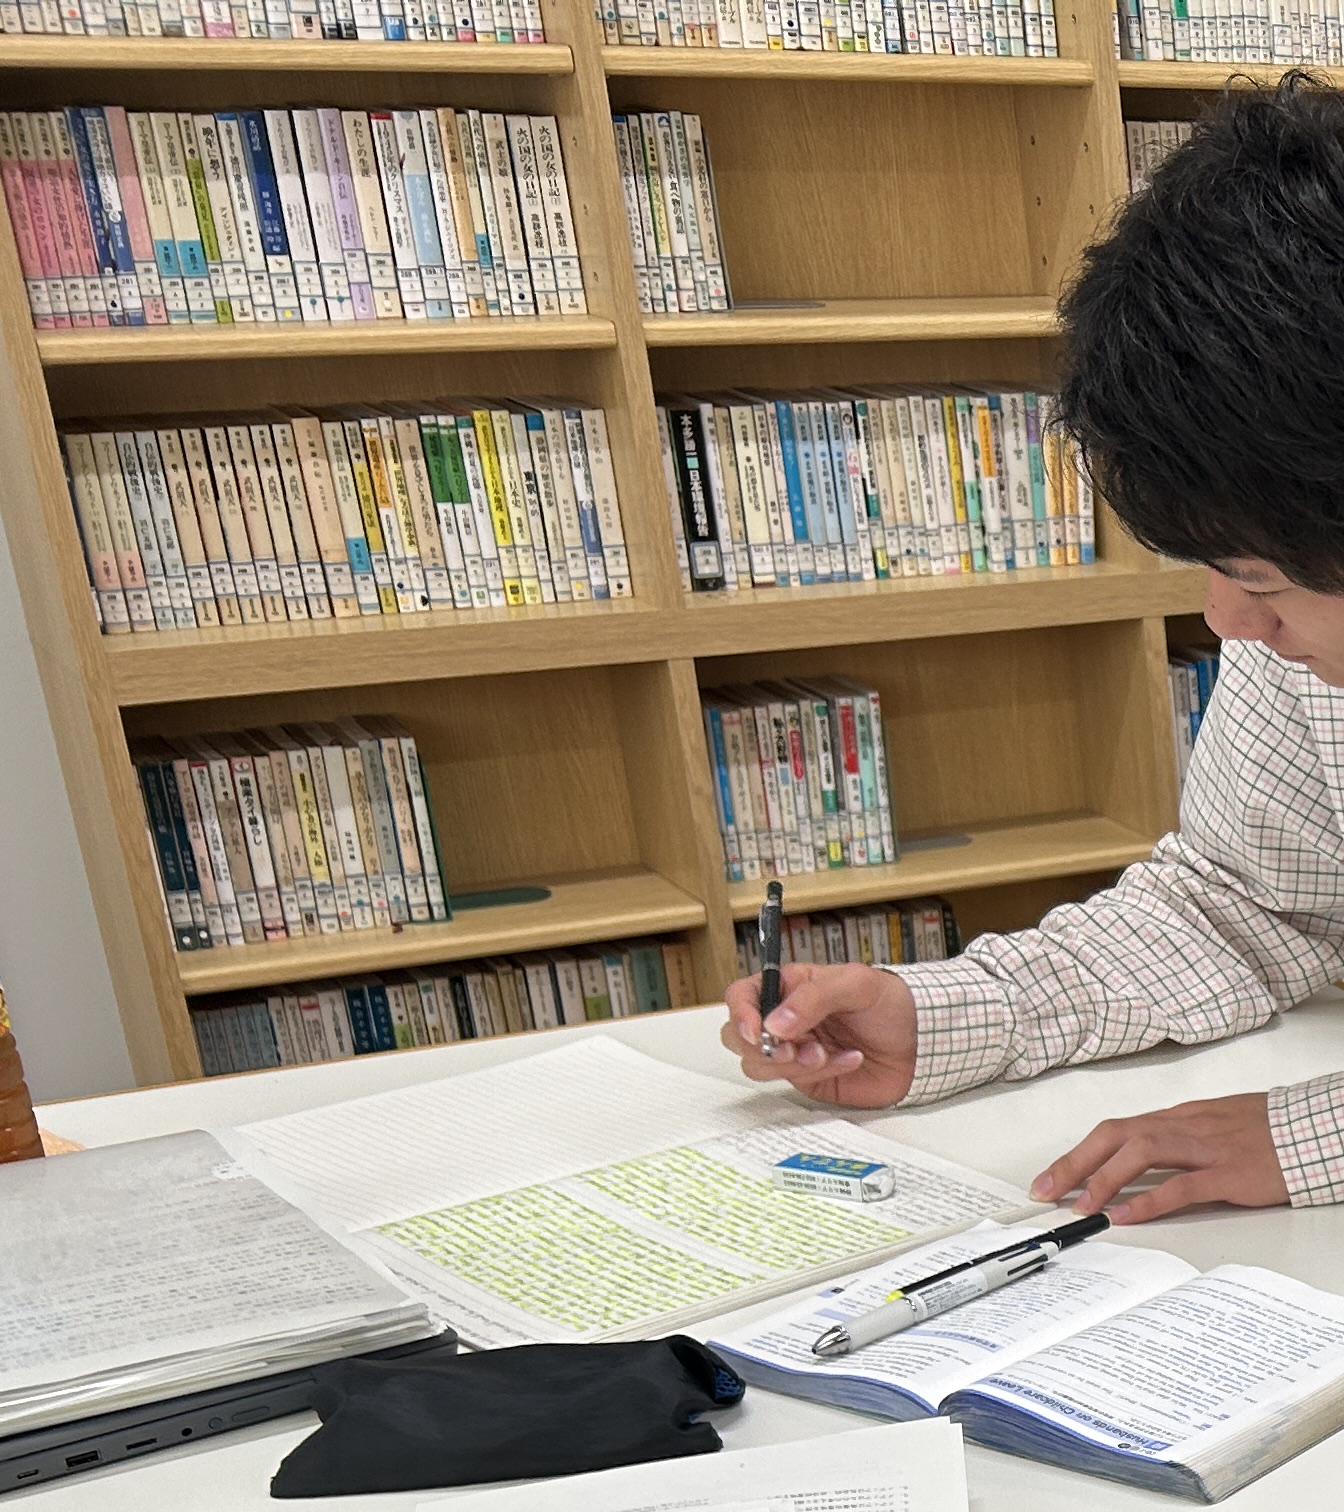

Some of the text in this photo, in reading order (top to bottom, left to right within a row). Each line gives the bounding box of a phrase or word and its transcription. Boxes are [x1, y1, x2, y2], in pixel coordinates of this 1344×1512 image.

[988, 1377, 1150, 1446] Husbands on Childcare Leave
